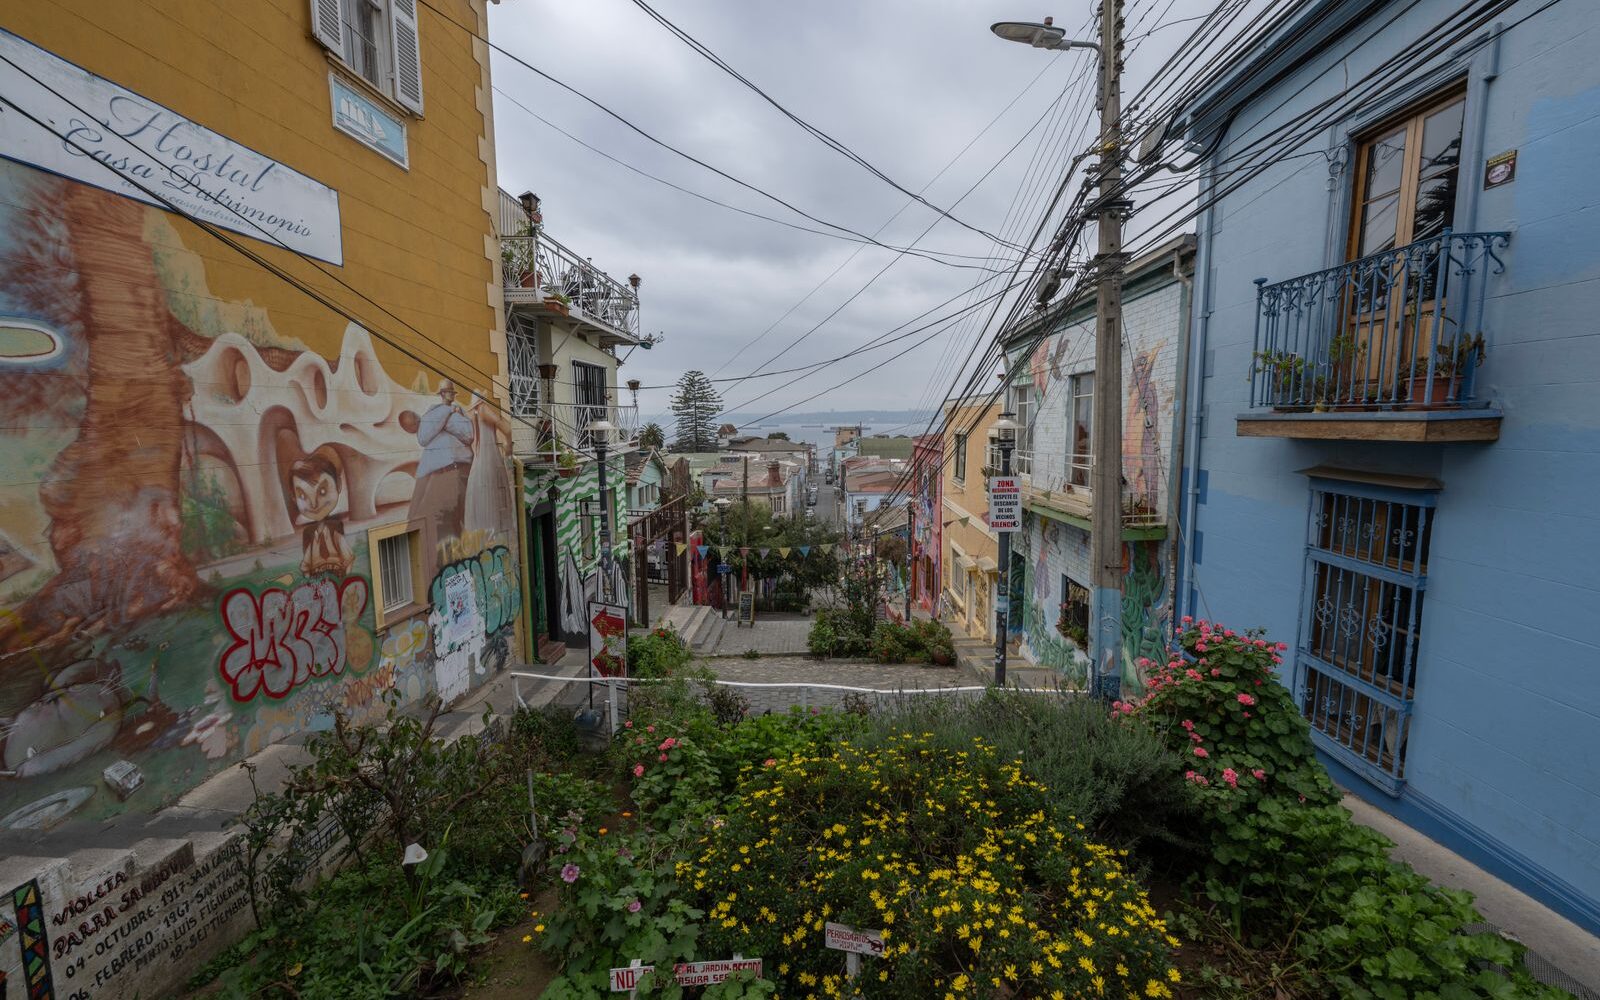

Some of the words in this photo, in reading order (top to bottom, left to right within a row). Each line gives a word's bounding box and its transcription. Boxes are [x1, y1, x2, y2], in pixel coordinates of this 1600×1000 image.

[102, 96, 275, 192] Hostal
[63, 118, 154, 178] Casa
[162, 164, 312, 237] Patrimonio
[52, 871, 128, 926] VIOLETA
[53, 906, 118, 960] PARRA
[616, 970, 635, 989] NO
